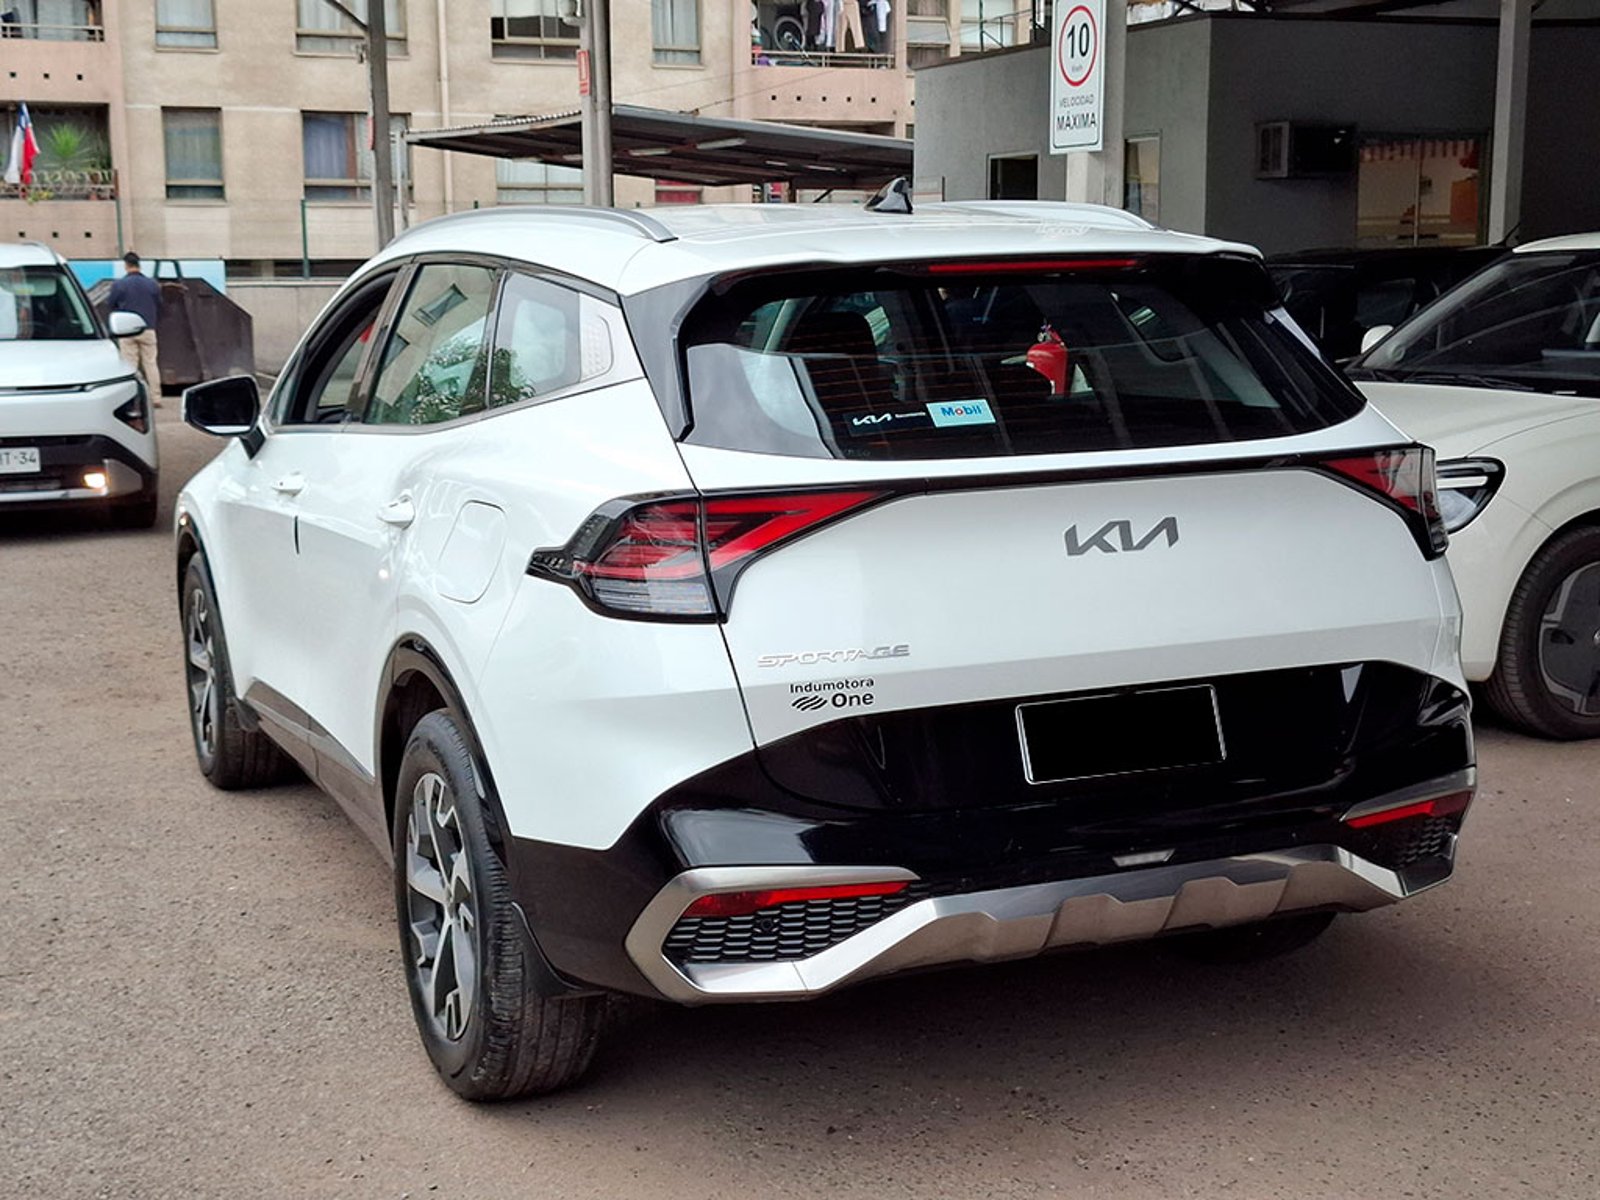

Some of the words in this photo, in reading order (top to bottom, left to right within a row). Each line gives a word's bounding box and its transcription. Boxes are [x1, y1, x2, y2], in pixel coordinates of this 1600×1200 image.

[1067, 23, 1090, 59] 10
[1057, 111, 1097, 131] MÁXIMA
[852, 412, 893, 426] KIA
[941, 405, 983, 417] Mobil
[1064, 516, 1179, 556] KIA
[757, 644, 910, 668] SPORTAGE
[790, 678, 875, 694] Indumotora
[831, 692, 874, 708] One
